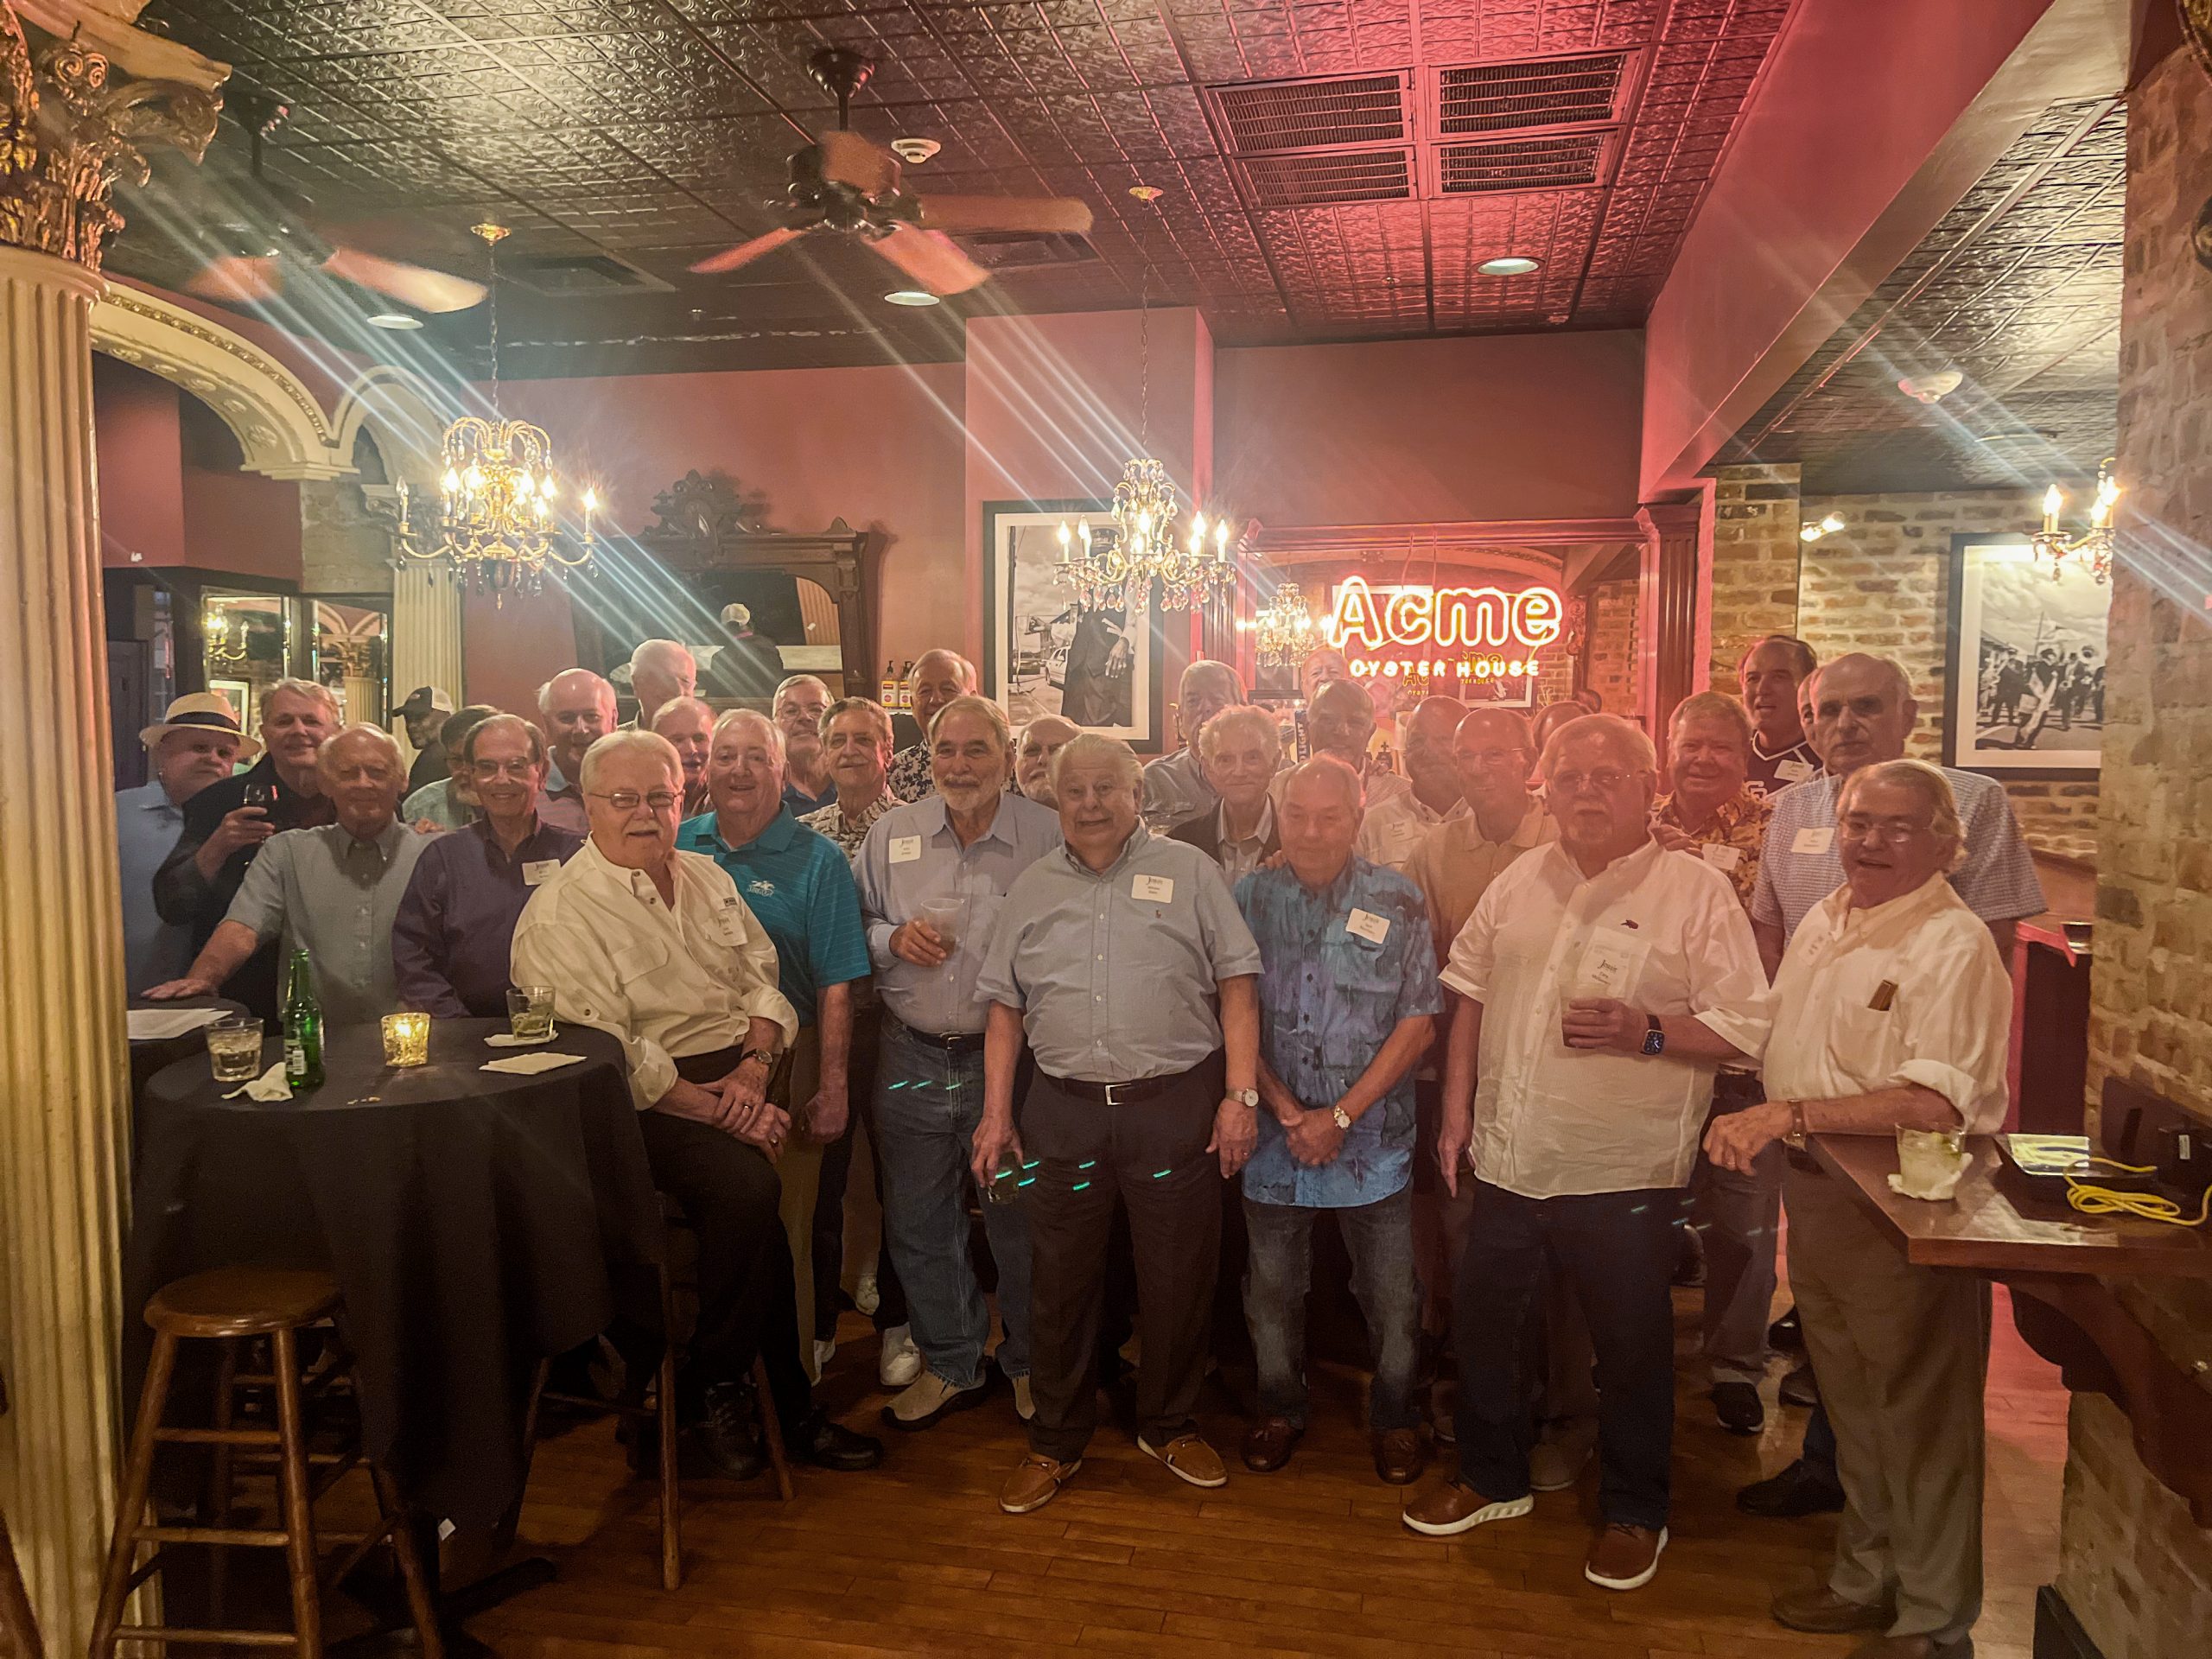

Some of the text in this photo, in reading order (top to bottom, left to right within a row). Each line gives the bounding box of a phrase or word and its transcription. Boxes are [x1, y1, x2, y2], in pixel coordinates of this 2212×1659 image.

[1328, 575, 1562, 647] Acme
[1349, 658, 1539, 677] OYSTER HOUSE
